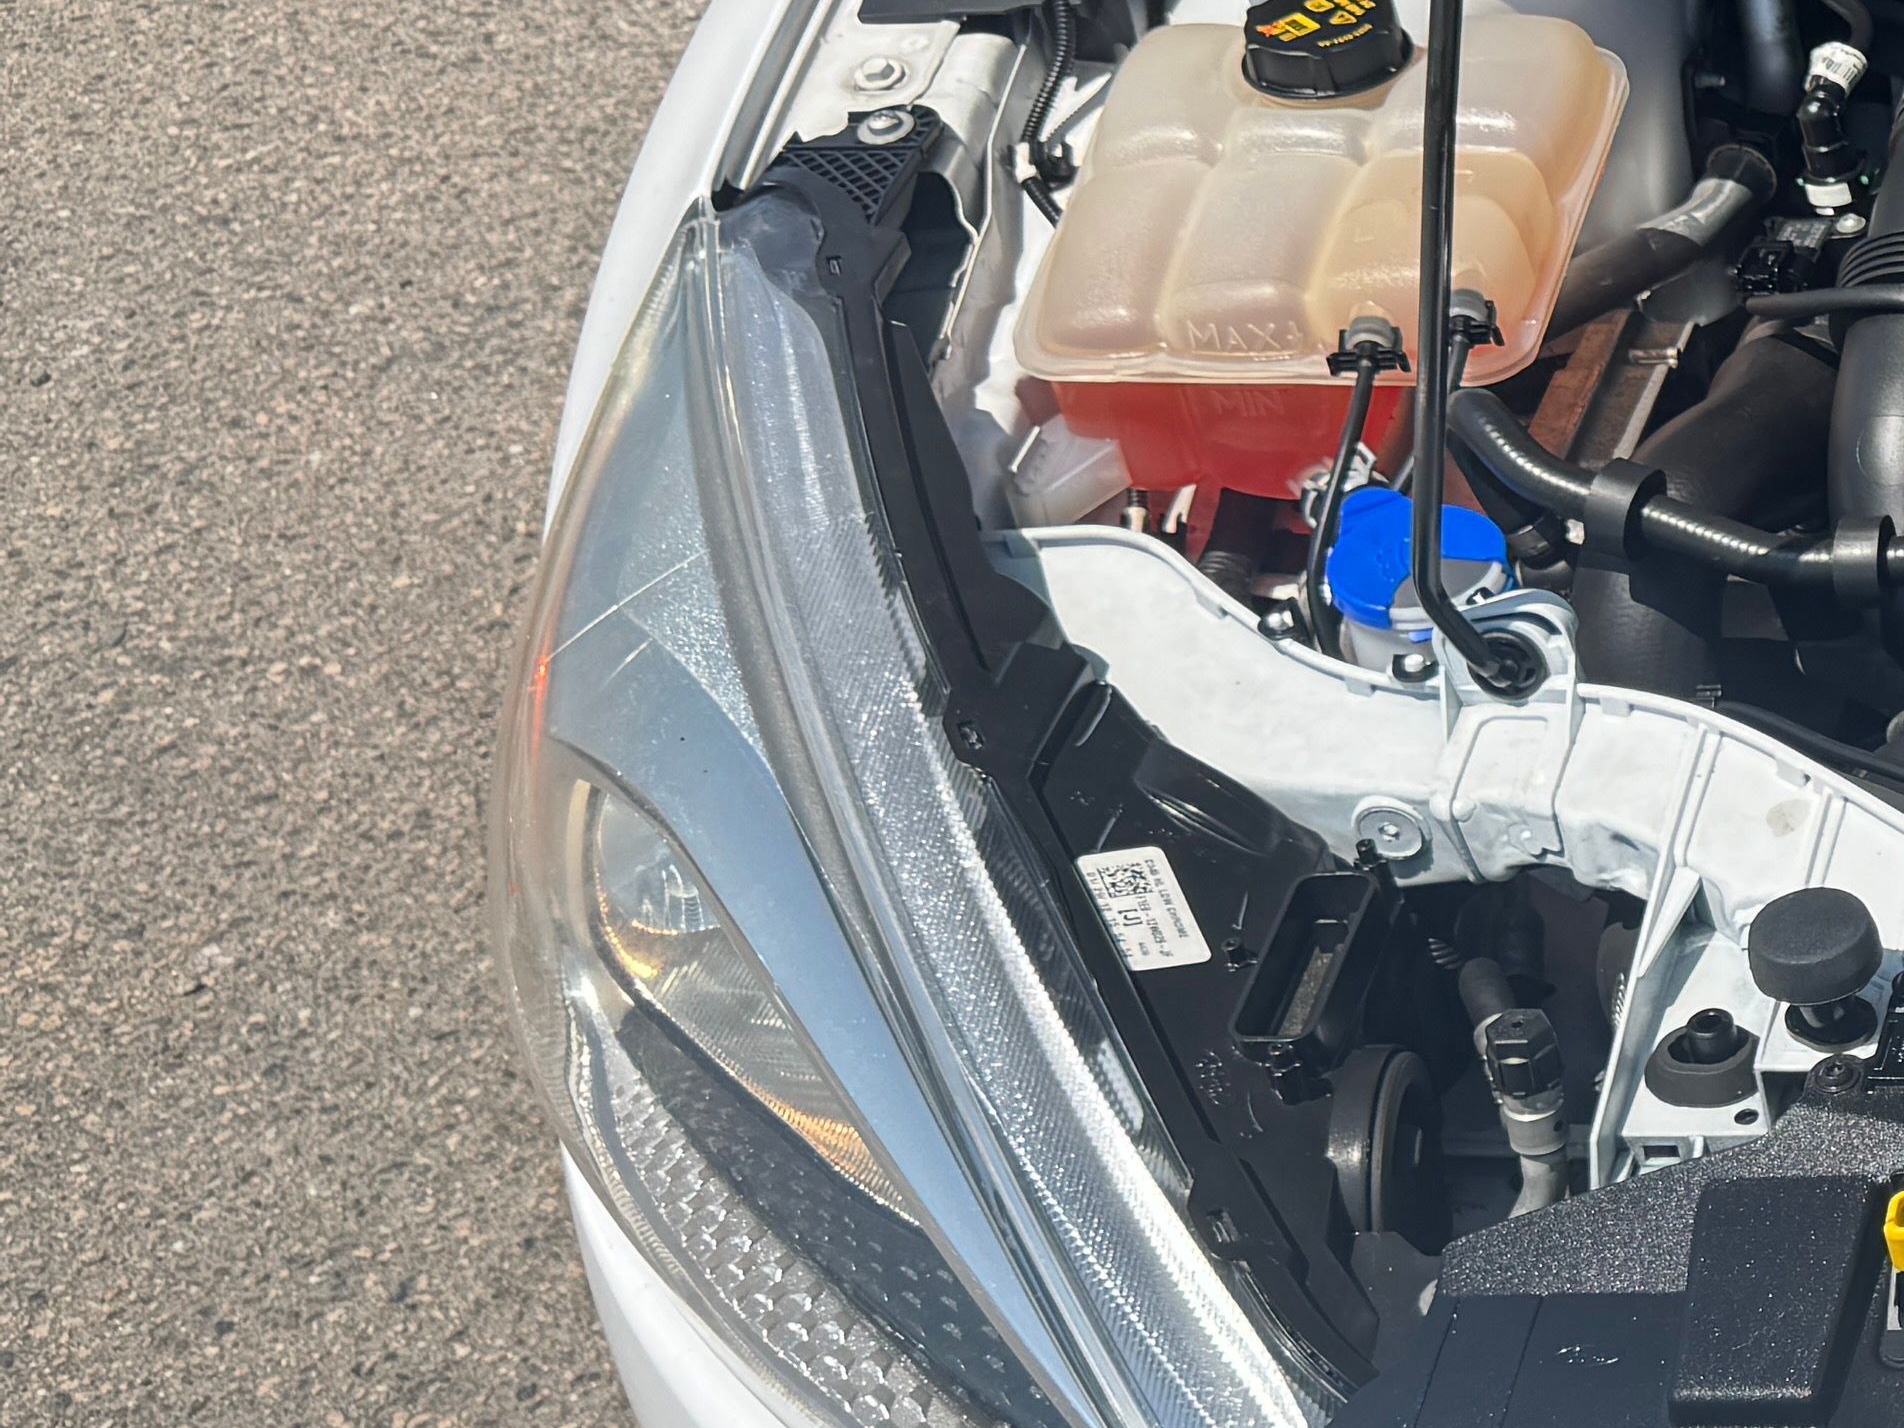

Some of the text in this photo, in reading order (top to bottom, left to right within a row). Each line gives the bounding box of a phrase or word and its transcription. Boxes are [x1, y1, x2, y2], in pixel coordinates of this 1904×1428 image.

[1186, 319, 1282, 350] MAX
[1210, 389, 1286, 417] MIN
[1159, 890, 1173, 905] LOW
[1167, 907, 1189, 938] CHROME
